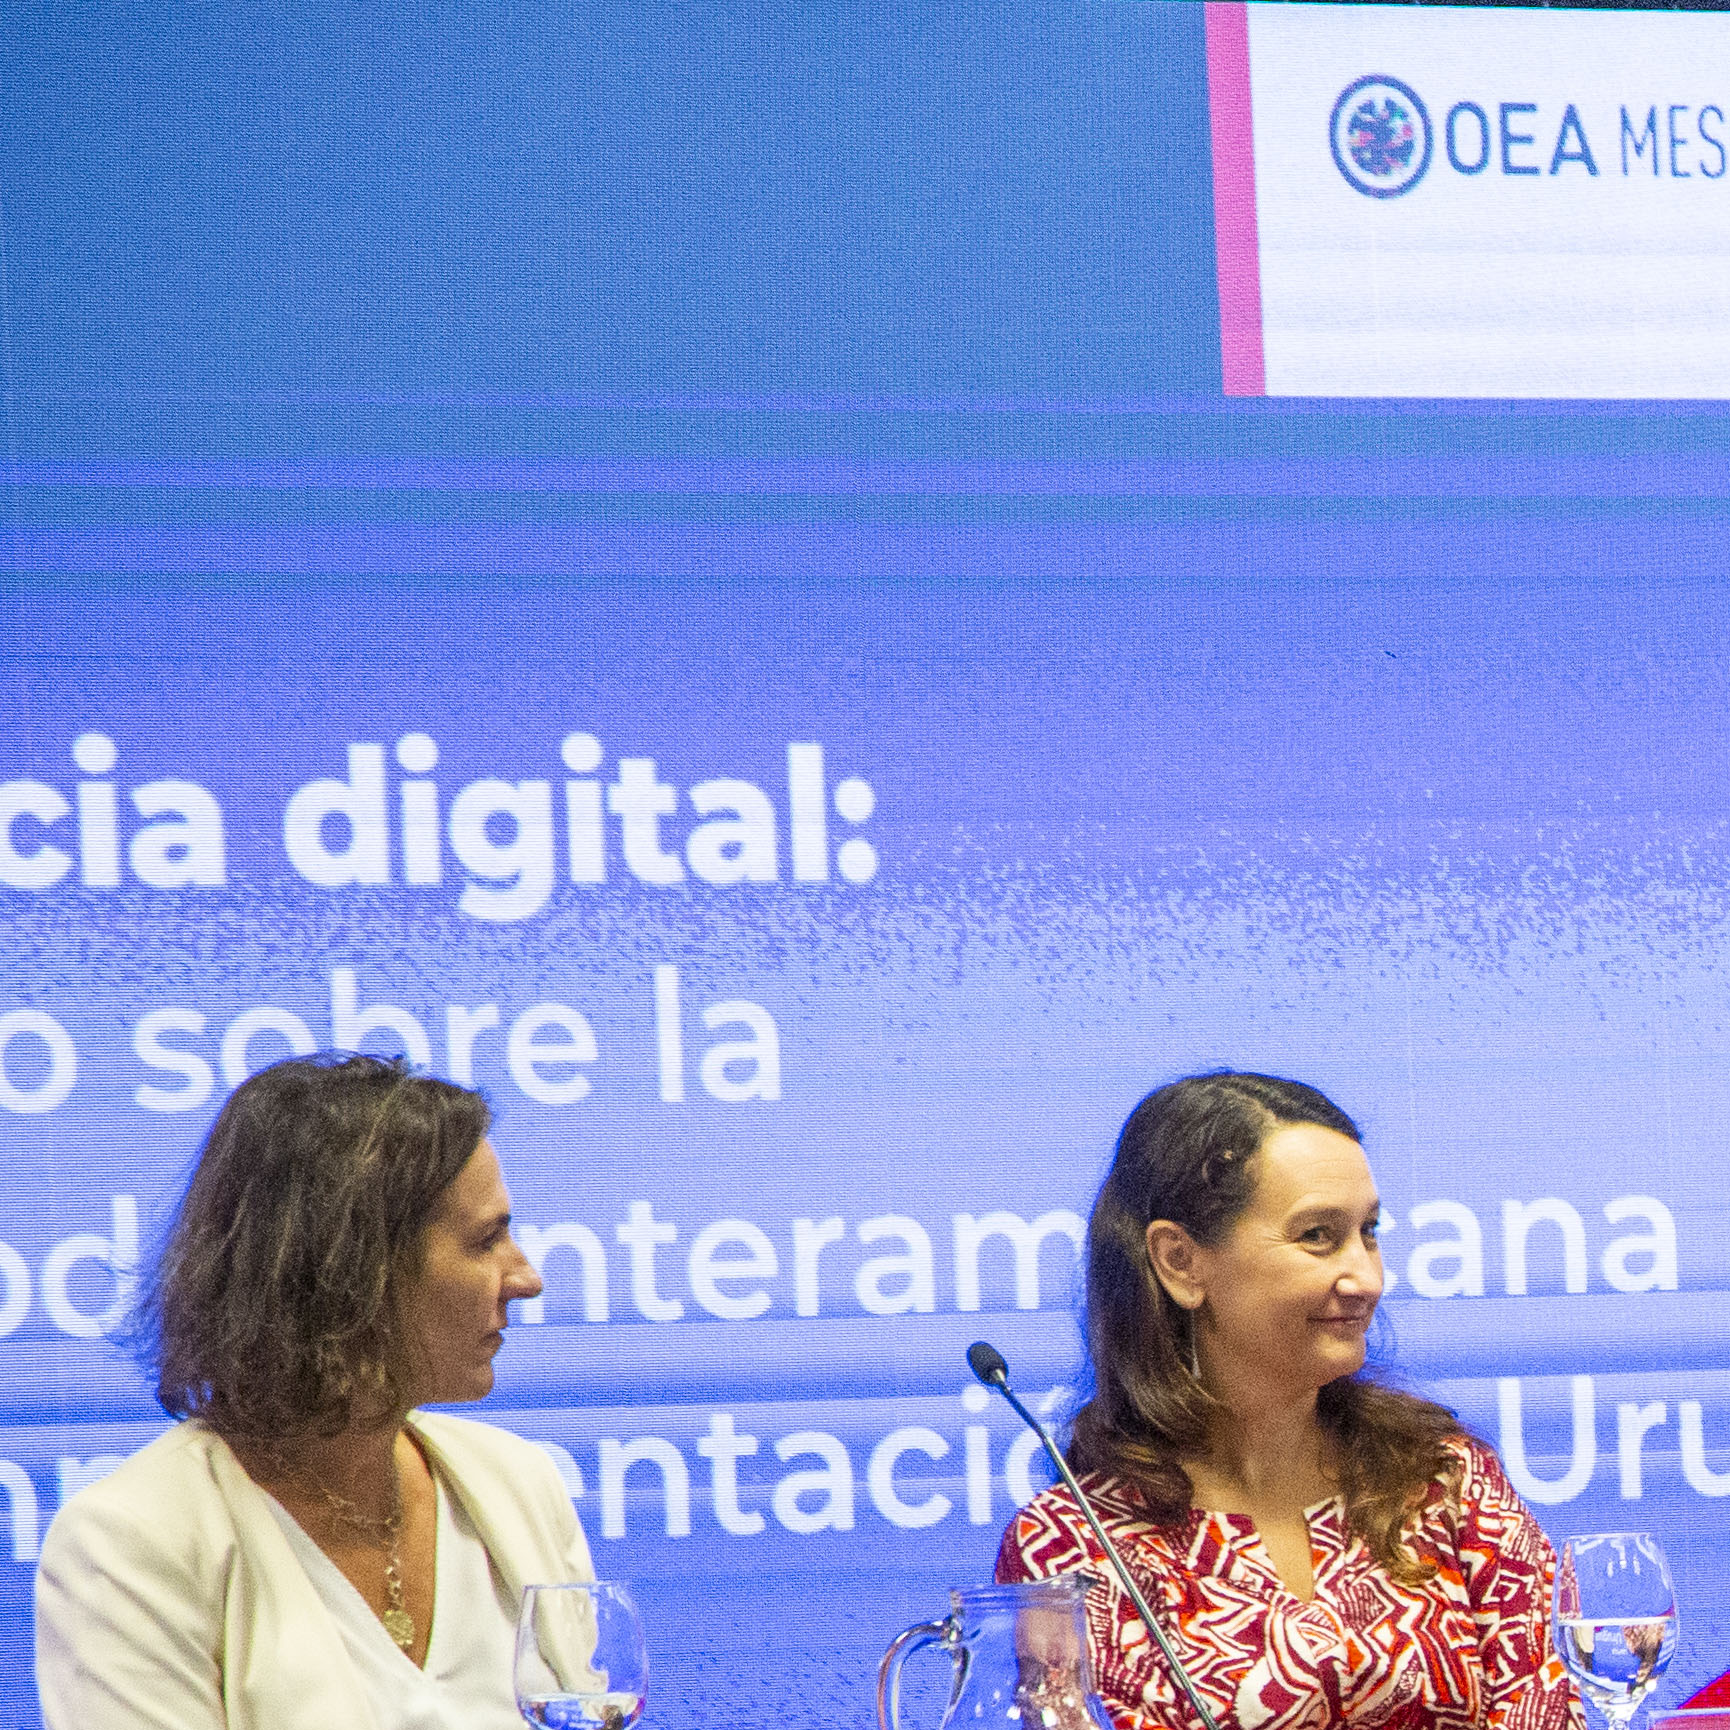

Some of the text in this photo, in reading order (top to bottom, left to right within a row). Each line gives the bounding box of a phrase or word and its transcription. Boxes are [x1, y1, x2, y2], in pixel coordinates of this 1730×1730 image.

[1444, 100, 1600, 177] OEA
[282, 731, 879, 922] digital:
[133, 967, 600, 1113] sobre
[654, 964, 781, 1104] la
